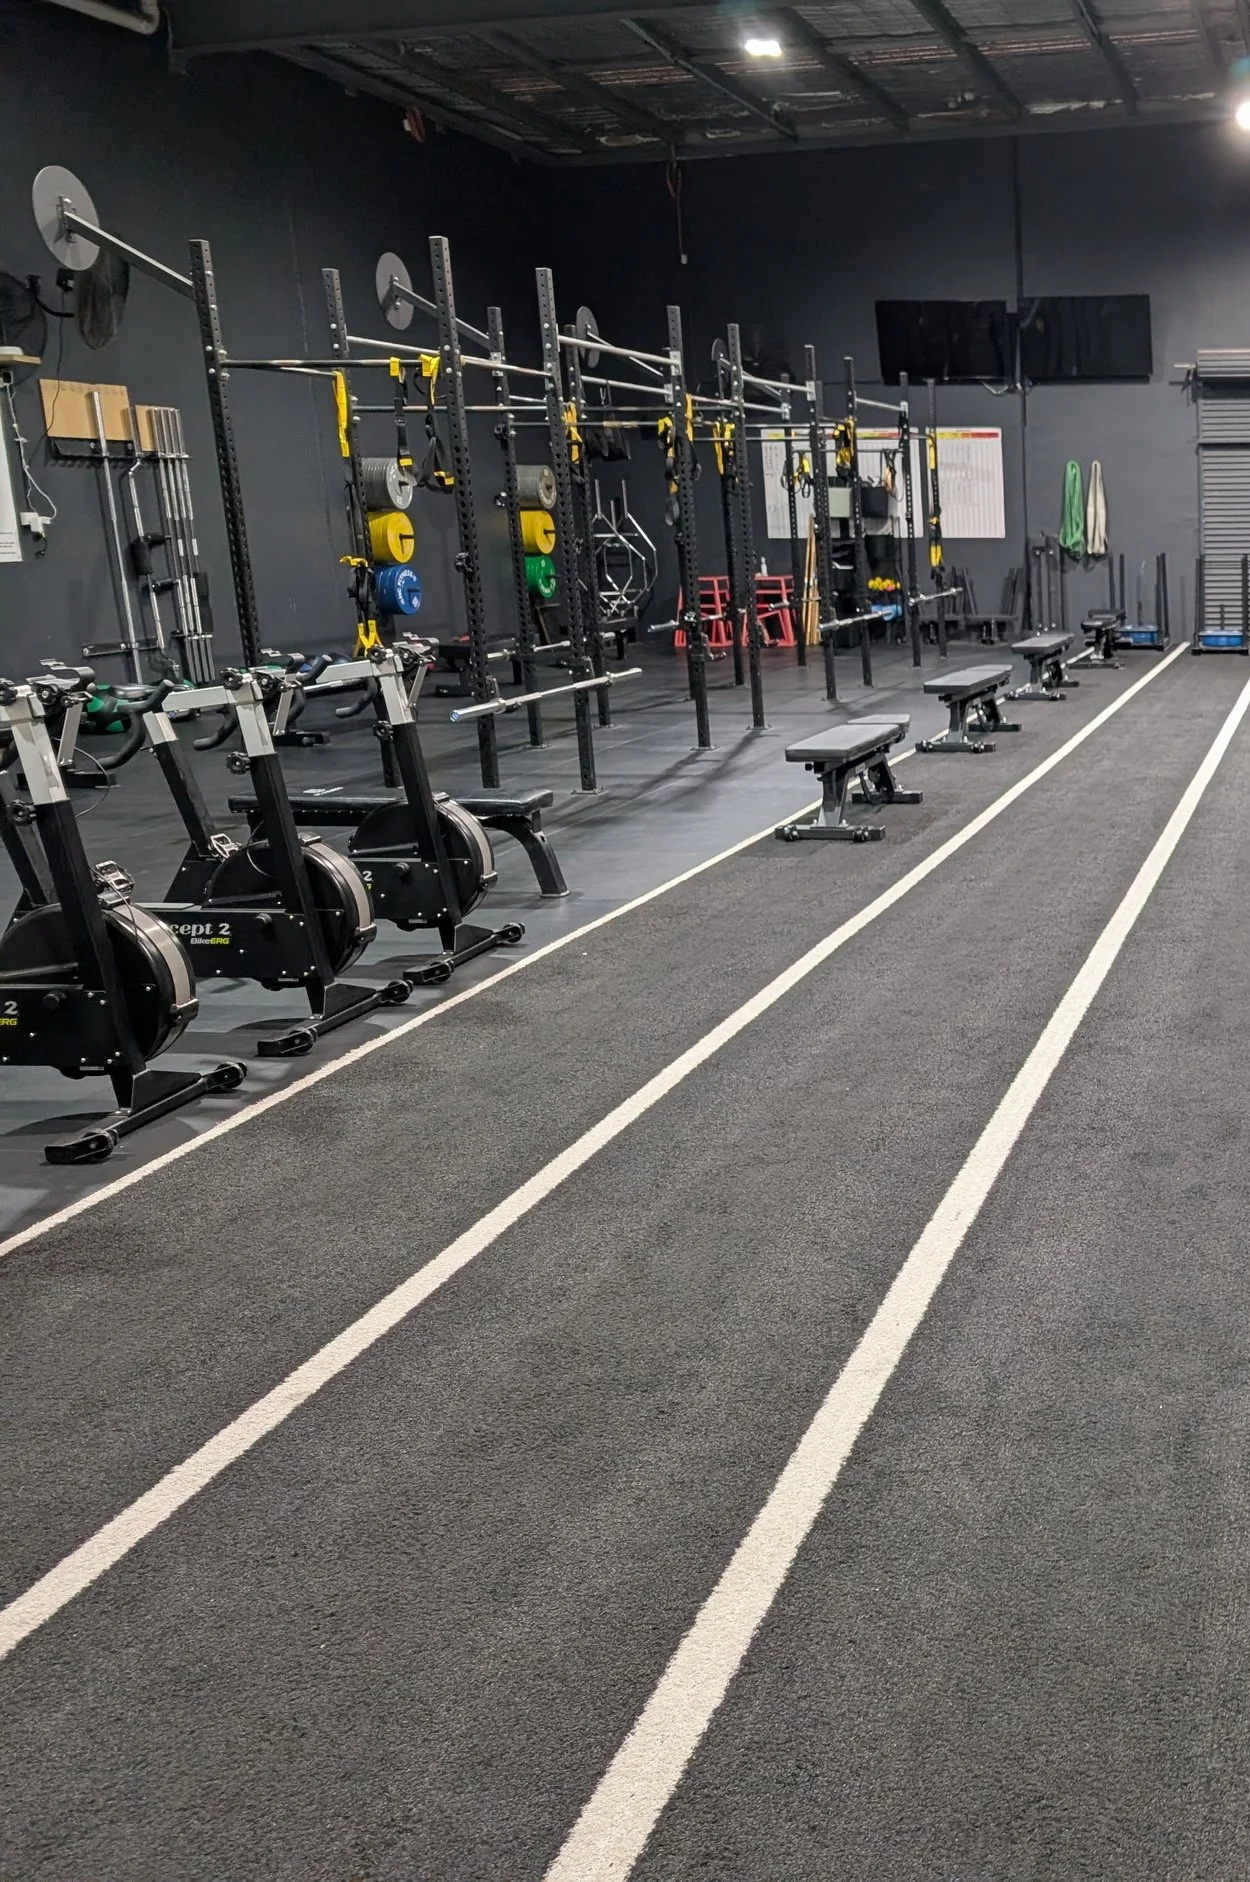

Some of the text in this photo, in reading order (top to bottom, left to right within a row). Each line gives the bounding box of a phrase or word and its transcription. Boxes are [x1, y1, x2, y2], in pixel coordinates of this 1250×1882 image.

[363, 871, 372, 881] 2
[170, 923, 230, 936] cept 2
[4, 1001, 18, 1015] 2
